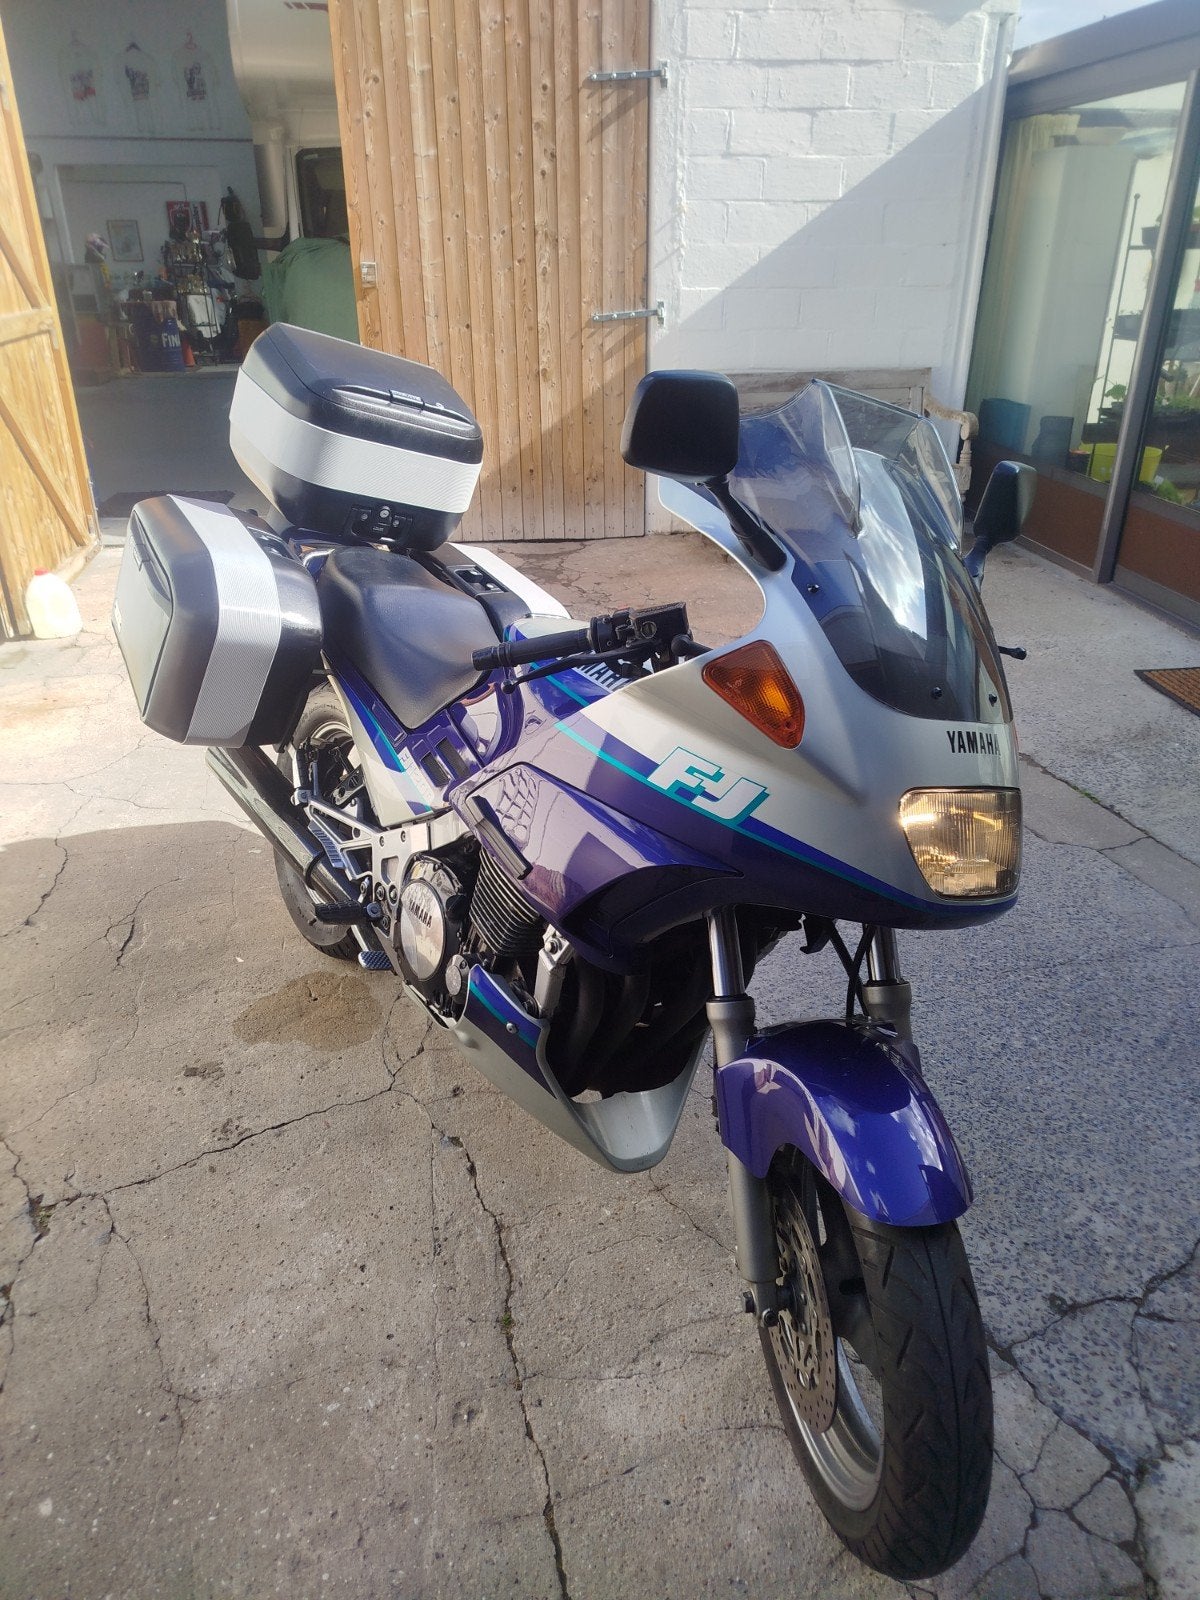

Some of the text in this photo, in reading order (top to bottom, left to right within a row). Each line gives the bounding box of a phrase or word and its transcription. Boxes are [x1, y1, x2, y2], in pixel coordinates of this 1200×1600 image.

[946, 730, 1001, 756] YAMAHA
[646, 746, 770, 823] FJ
[408, 899, 433, 928] YAMAHA
